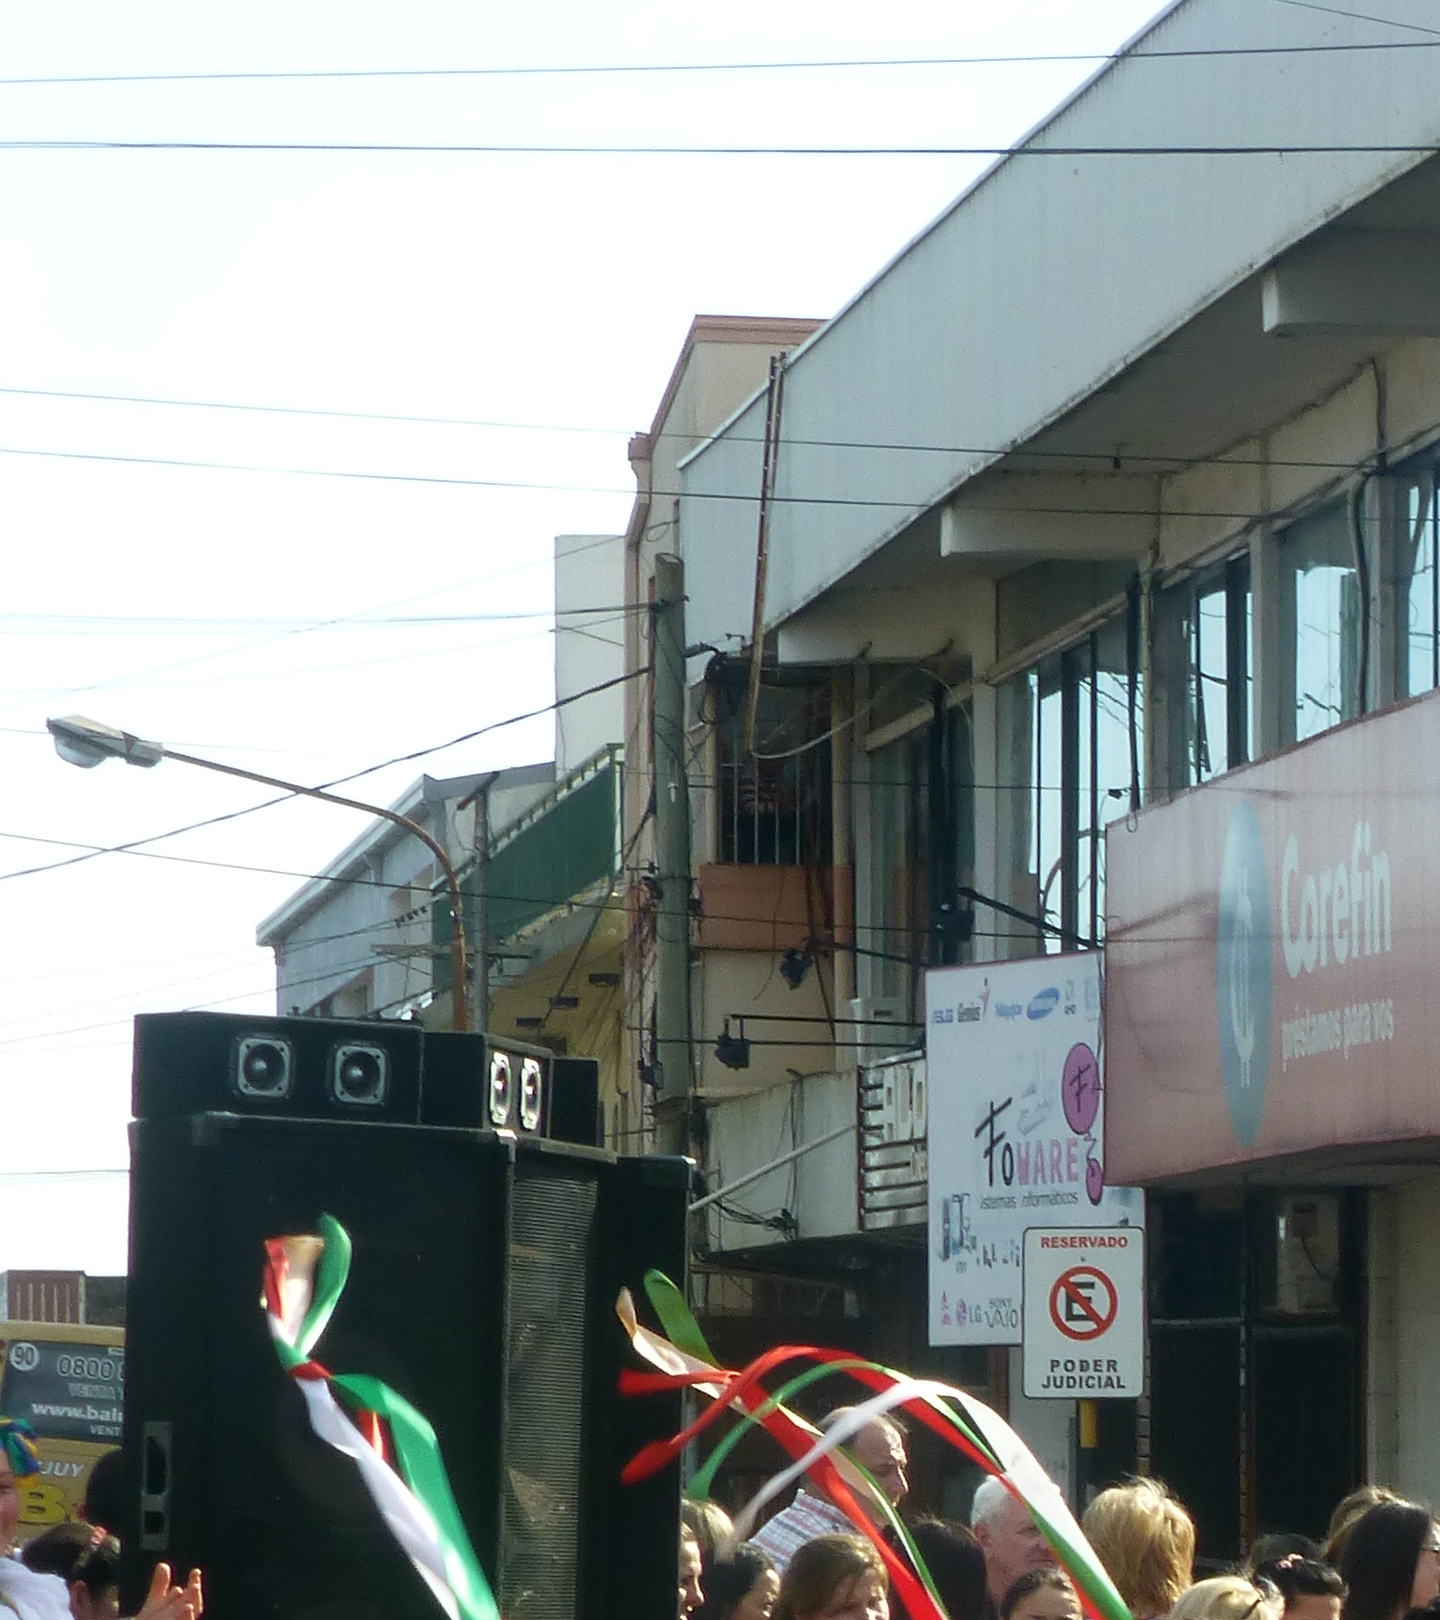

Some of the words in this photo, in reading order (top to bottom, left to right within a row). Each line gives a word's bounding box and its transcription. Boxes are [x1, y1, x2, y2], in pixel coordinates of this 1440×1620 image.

[1281, 820, 1392, 979] Corefin
[1343, 1001, 1372, 1060] para
[1372, 998, 1394, 1042] vos
[1040, 1236, 1128, 1249] RESERVADO
[13, 1346, 36, 1366] 90
[1050, 1358, 1119, 1373] PODER
[57, 1354, 115, 1381] 0800
[1041, 1375, 1127, 1390] JUDICIAL
